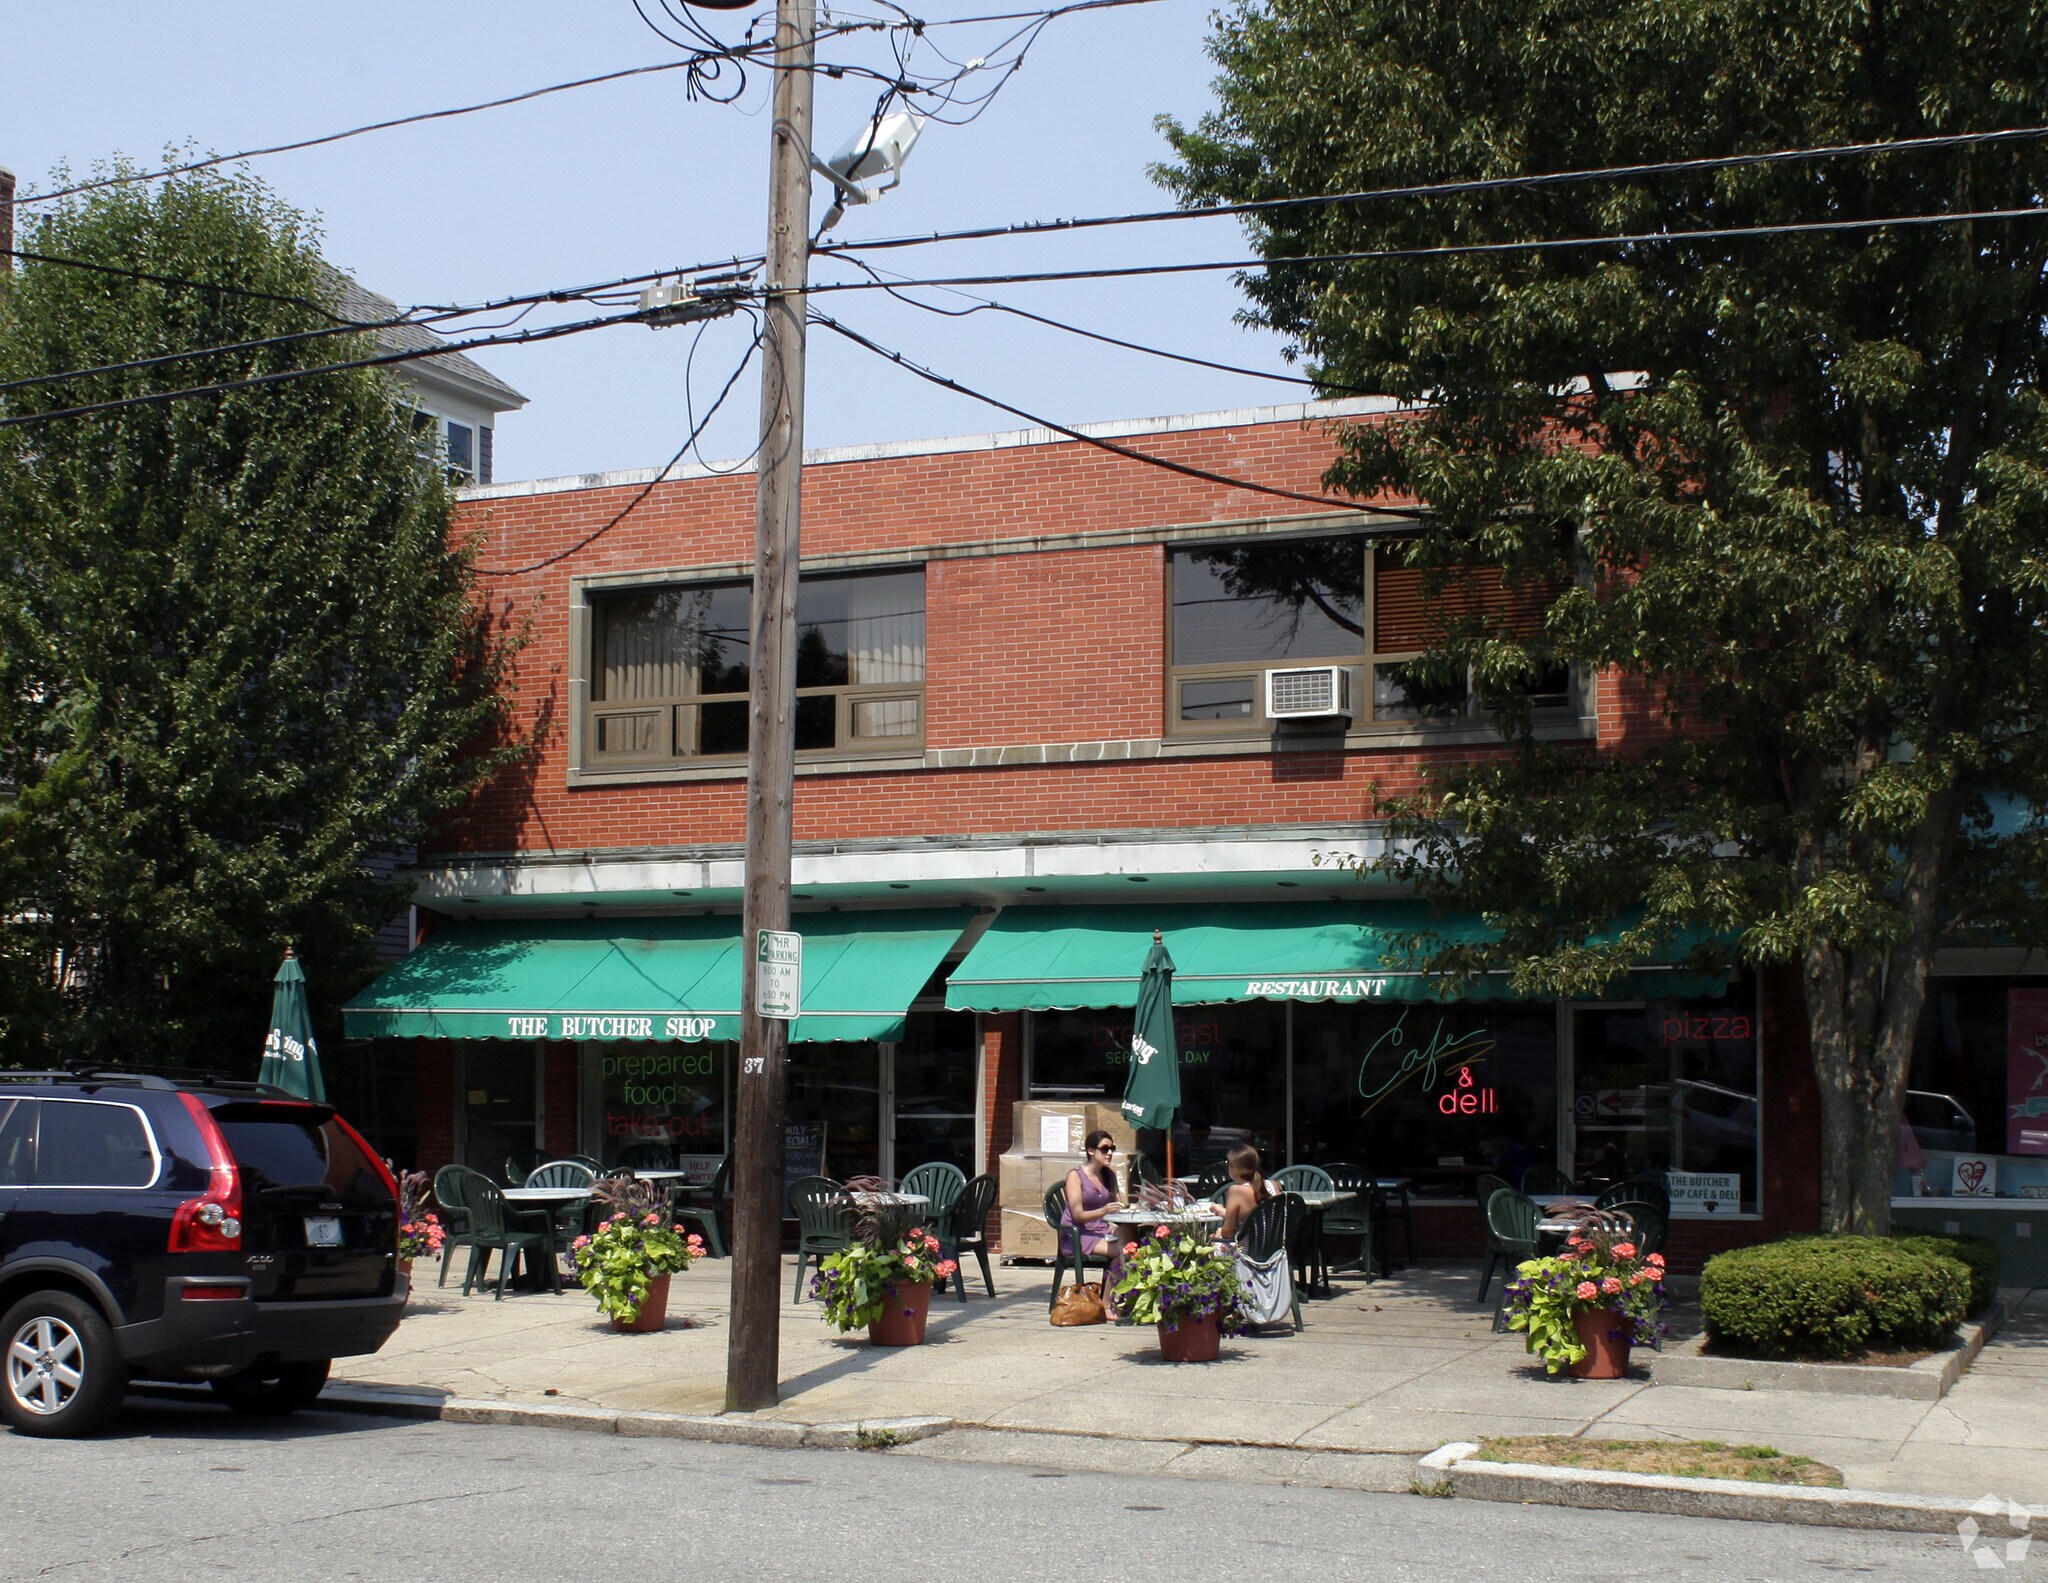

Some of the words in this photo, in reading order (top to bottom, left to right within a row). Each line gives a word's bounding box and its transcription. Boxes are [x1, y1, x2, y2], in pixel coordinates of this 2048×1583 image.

[760, 935, 768, 956] 2
[776, 937, 790, 949] HR
[768, 949, 798, 962] PARKING
[780, 967, 791, 977] AM
[770, 978, 780, 988] TO
[1245, 979, 1386, 996] RESTAURANT
[780, 990, 791, 1001] PM
[508, 1017, 548, 1036] THE
[561, 1017, 653, 1037] BUTCHER
[665, 1017, 716, 1038] SHOP
[1662, 1010, 1751, 1049] pizza
[1185, 1051, 1211, 1064] DAY
[602, 1049, 713, 1081] prepared
[744, 1057, 765, 1074] 37
[1458, 1066, 1473, 1088] &
[624, 1079, 691, 1105] foods
[689, 1161, 711, 1171] HELP
[1671, 1176, 1687, 1186] THE
[1689, 1176, 1730, 1187] BUTCHER
[1687, 1187, 1708, 1199] CAFÉ
[1710, 1189, 1717, 1199] &
[1719, 1190, 1739, 1200] DELI
